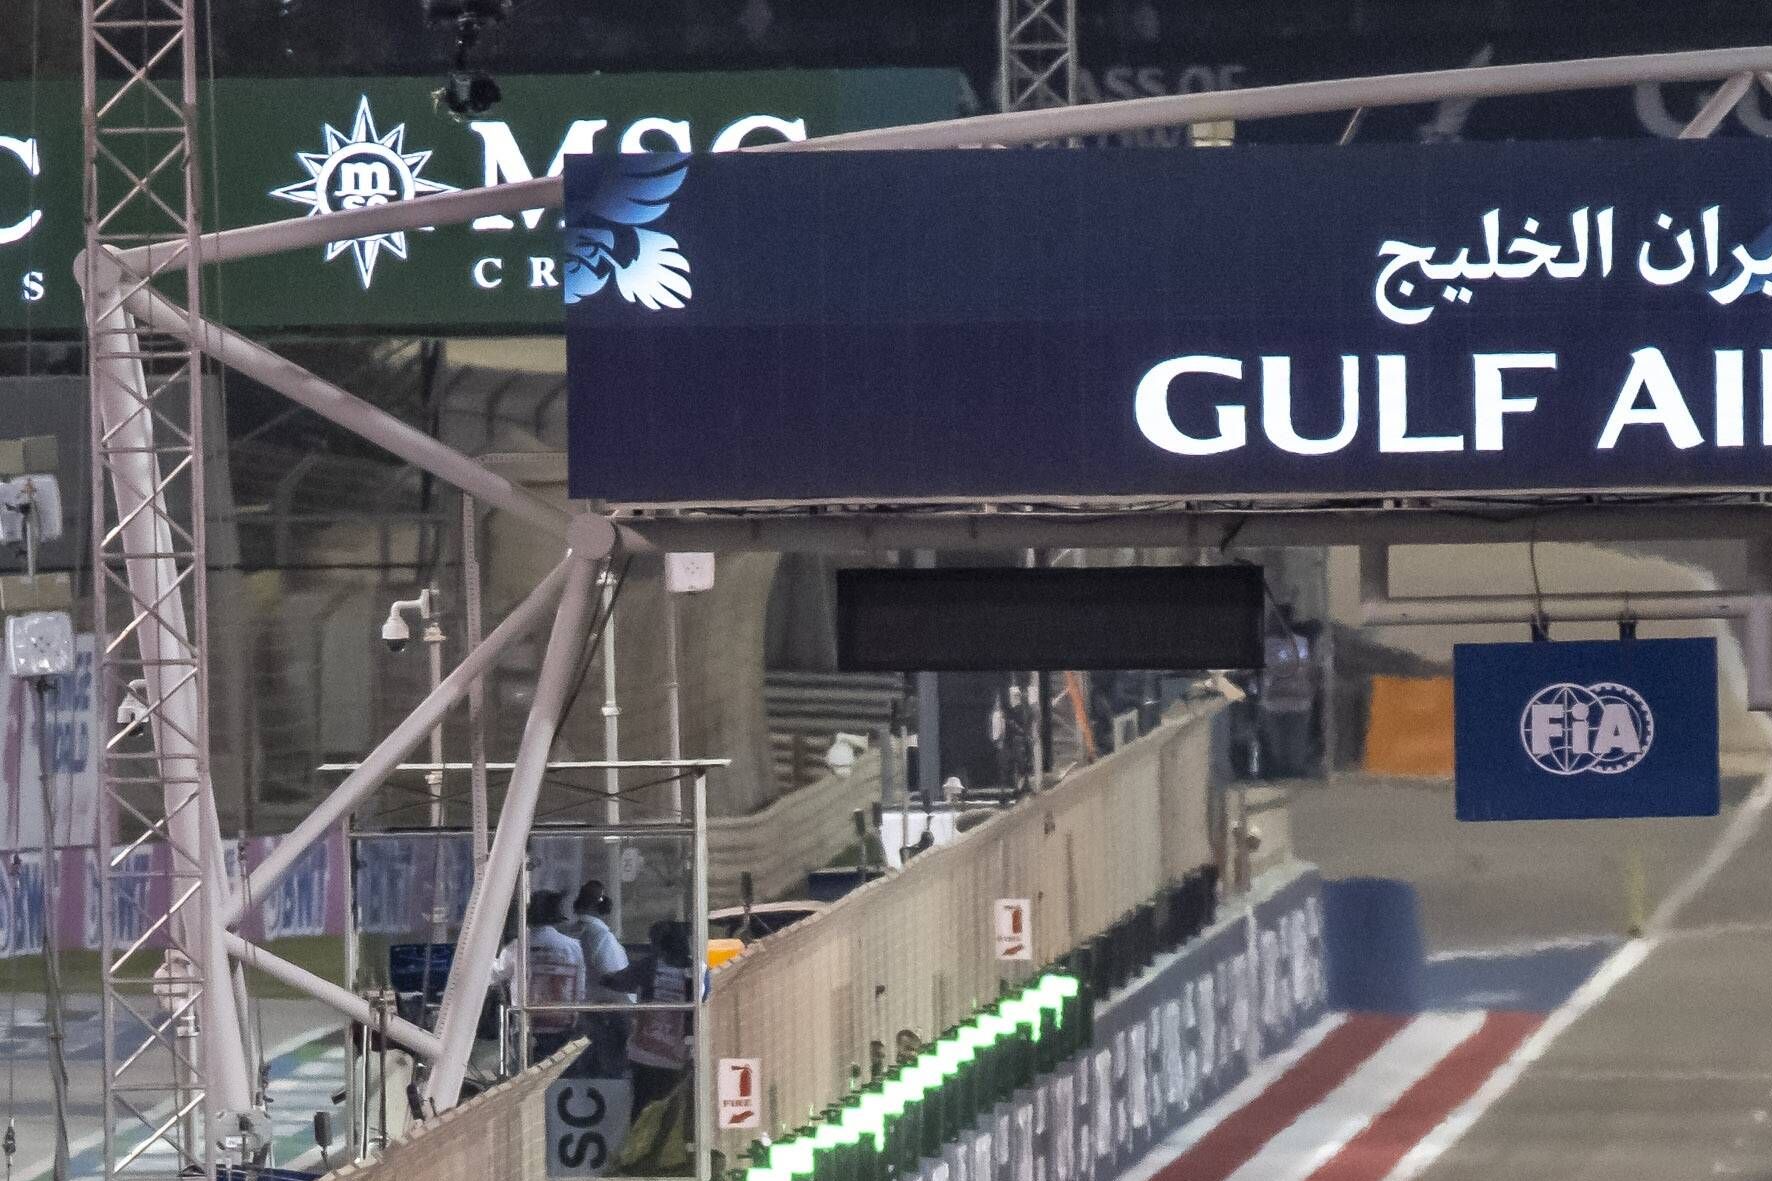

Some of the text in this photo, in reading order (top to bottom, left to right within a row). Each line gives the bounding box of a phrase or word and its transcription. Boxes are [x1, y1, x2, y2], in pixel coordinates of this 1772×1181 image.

[1375, 206, 1614, 325] الخليج
[1134, 352, 1557, 456] GULF
[557, 1085, 607, 1169] SC
[723, 1099, 751, 1108] FIRE
